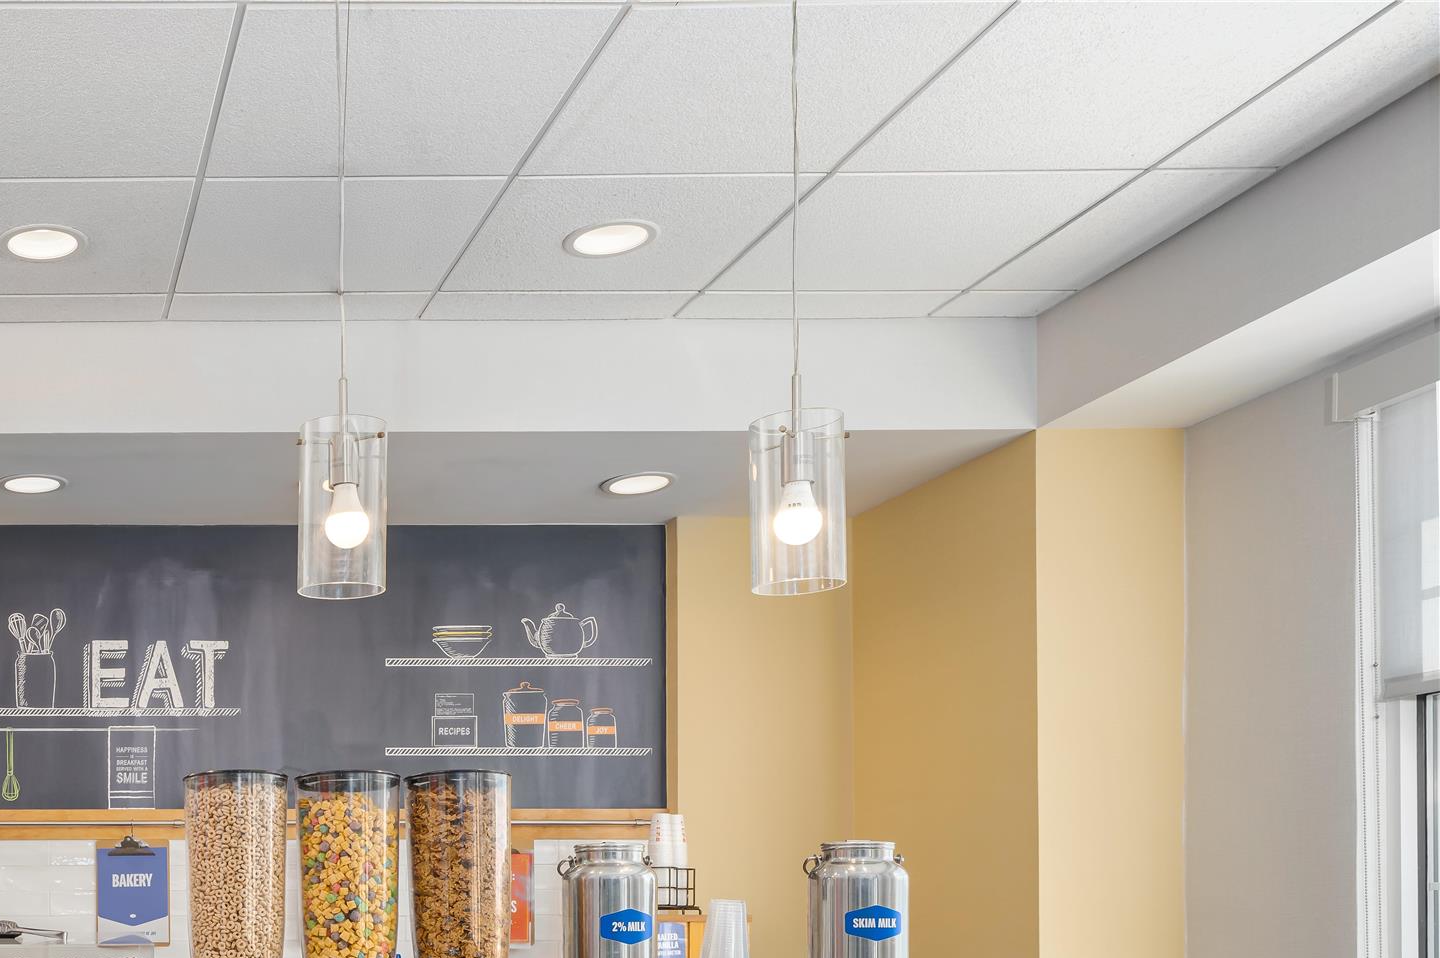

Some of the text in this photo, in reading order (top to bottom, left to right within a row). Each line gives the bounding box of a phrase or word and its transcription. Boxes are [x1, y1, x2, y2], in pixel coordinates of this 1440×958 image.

[89, 639, 229, 708] EAT
[512, 715, 539, 723] DELIGHT
[438, 727, 471, 736] RECIPES
[555, 721, 576, 731] CHEER
[595, 726, 608, 735] JOY
[116, 772, 148, 784] SMILE
[111, 873, 153, 888] BAKERY
[611, 921, 646, 932] 2% MILK
[852, 917, 897, 928] SKIM MILK
